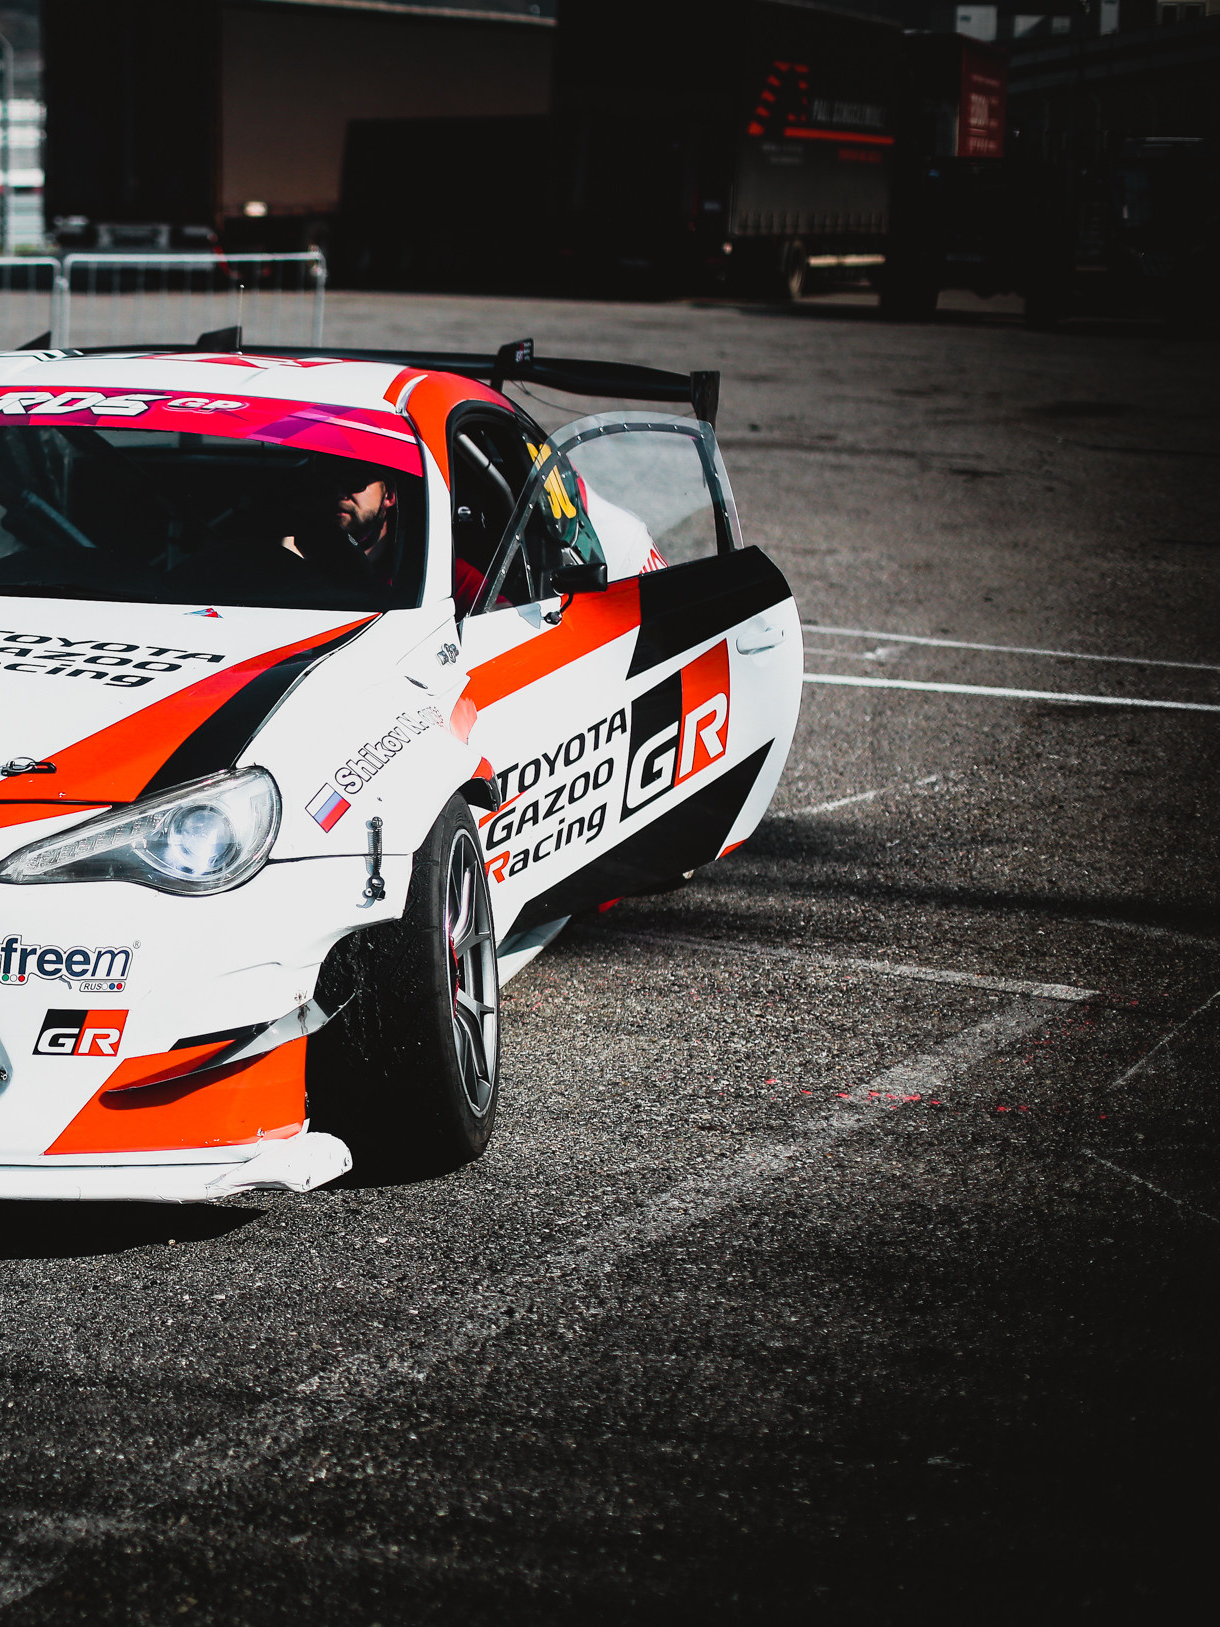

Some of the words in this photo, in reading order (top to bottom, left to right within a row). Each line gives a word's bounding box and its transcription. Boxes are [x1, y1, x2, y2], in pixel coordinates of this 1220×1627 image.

[167, 397, 244, 411] GP
[334, 726, 411, 794] Shikov
[496, 707, 627, 803] TOYOTA
[626, 691, 728, 809] GR
[485, 757, 614, 851] GAZOO
[485, 802, 607, 884] Racing
[1, 937, 130, 977] freem
[83, 982, 102, 991] RUS
[37, 1028, 121, 1055] GR
